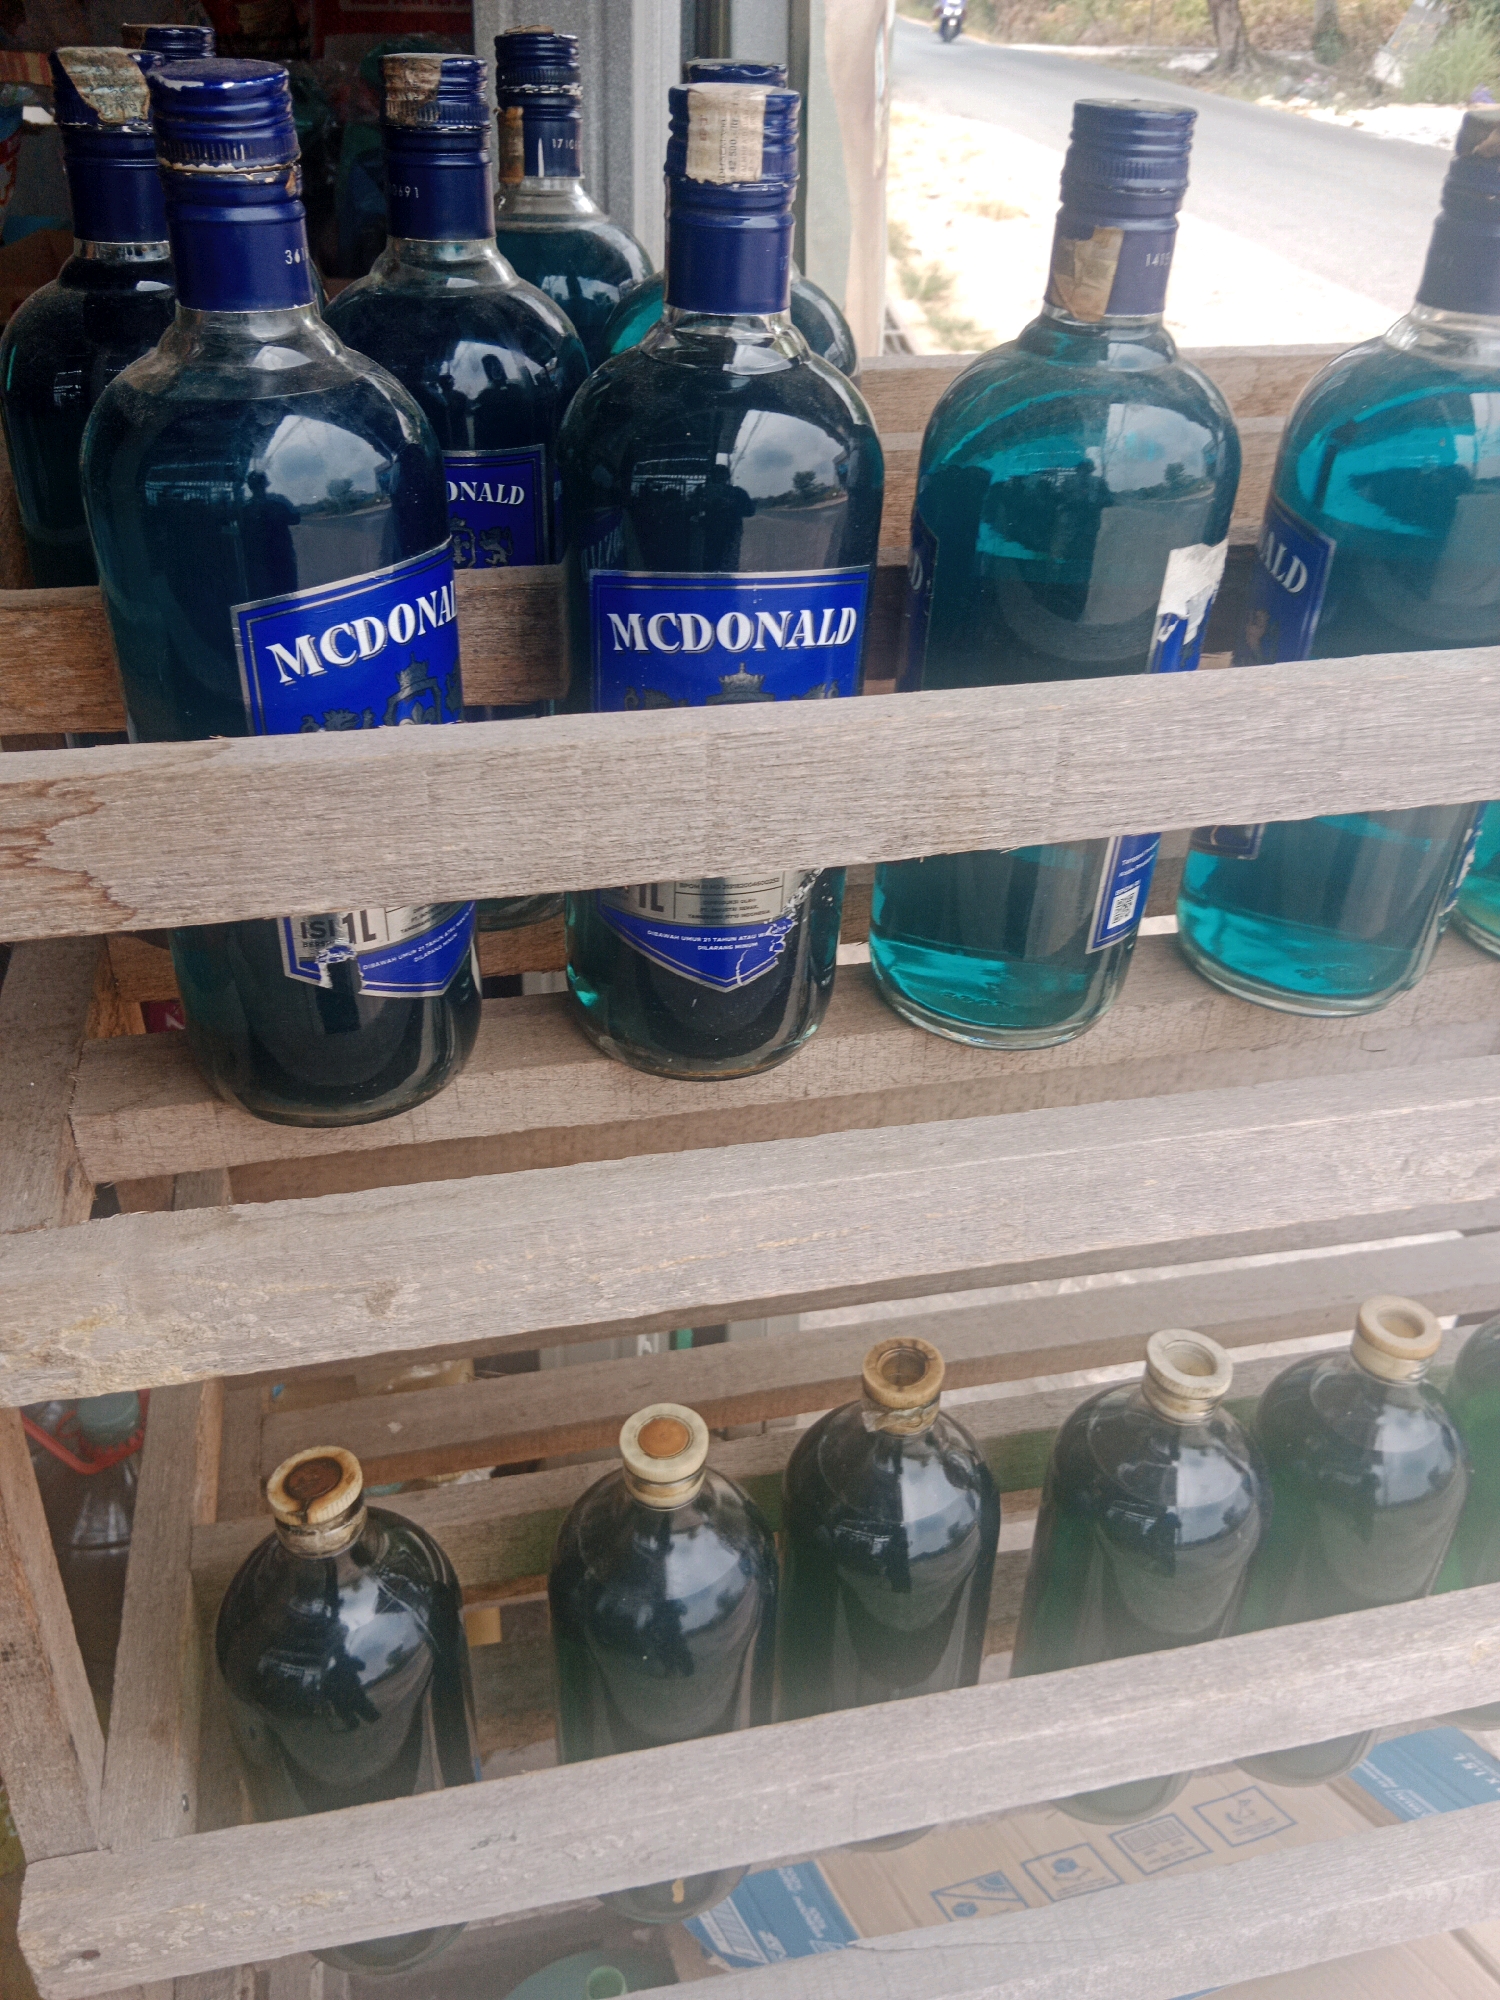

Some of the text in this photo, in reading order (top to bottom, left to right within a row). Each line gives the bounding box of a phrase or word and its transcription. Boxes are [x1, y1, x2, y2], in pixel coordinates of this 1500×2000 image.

[606, 606, 858, 653] MCDONALD
[301, 909, 377, 944] ISI 1L
[738, 933, 757, 941] ATAU
[362, 956, 397, 970] DIBAWAH
[398, 949, 417, 960] UMUR
[425, 935, 444, 948] TAHUN
[413, 944, 443, 963] DILARANG
[735, 941, 759, 950] MINUM
